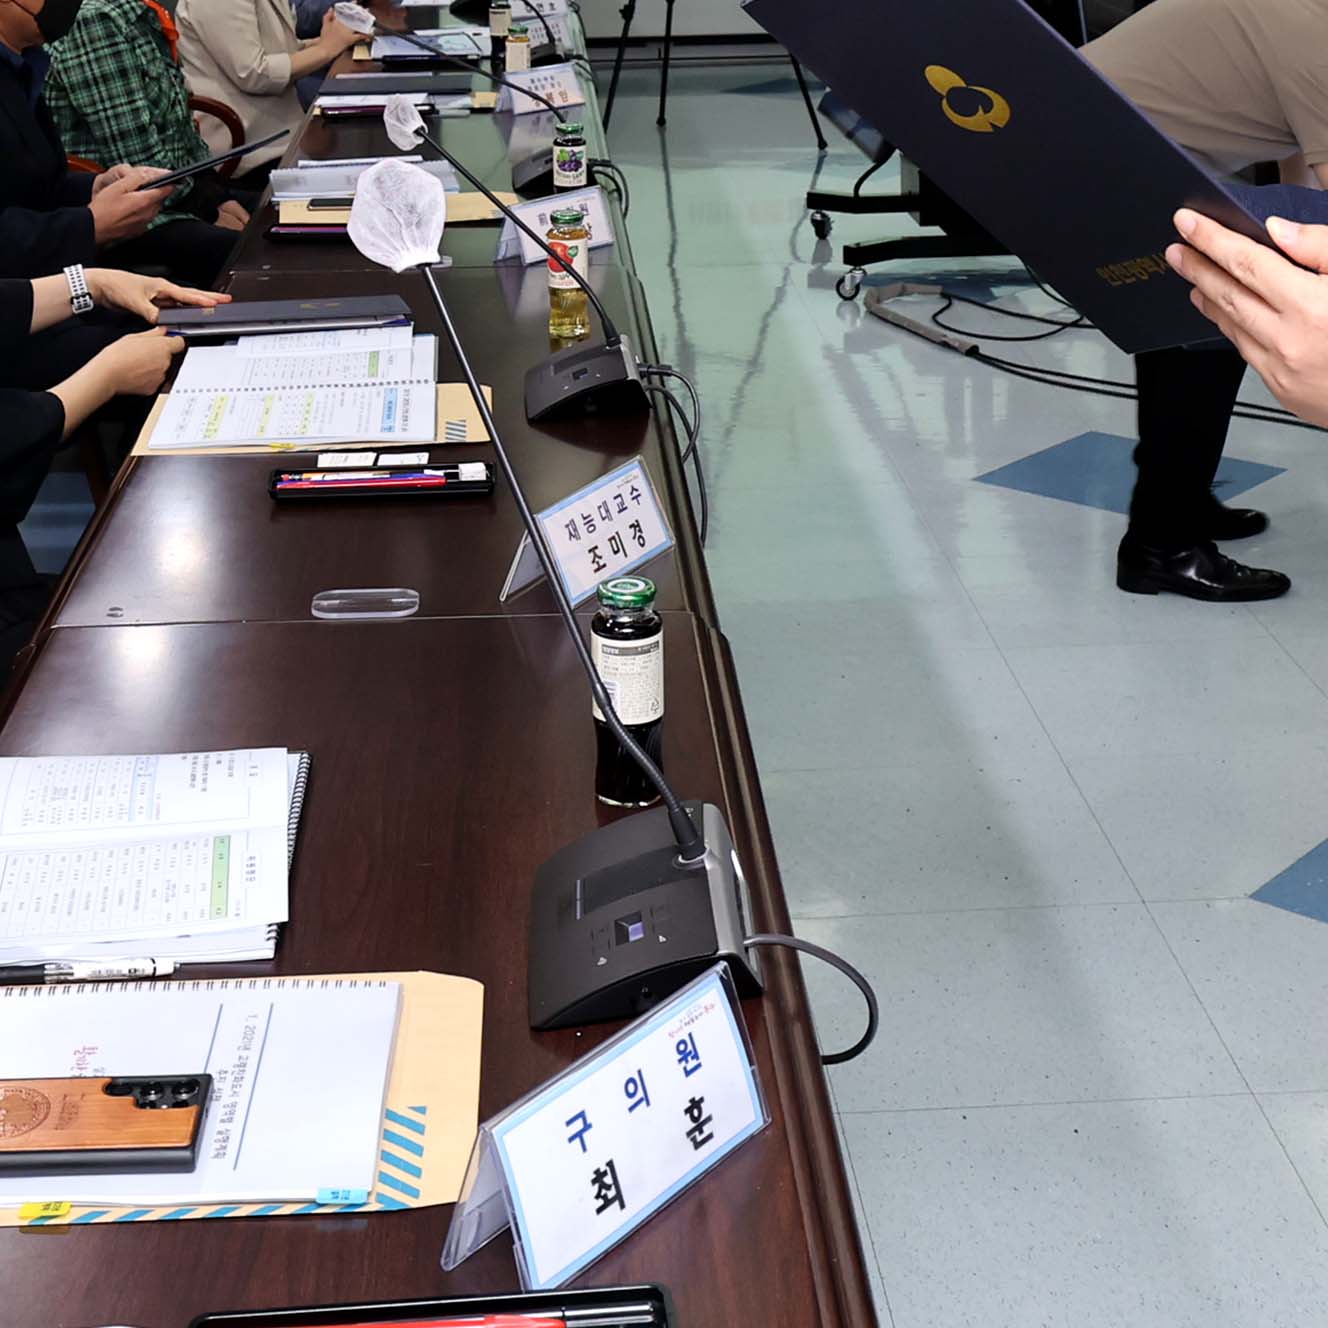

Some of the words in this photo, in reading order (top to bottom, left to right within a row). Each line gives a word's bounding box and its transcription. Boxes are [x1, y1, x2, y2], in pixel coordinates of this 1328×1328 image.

[564, 484, 643, 541] 재능대교수
[587, 519, 646, 573] 조미경
[229, 1055, 250, 1098] 고령친화도시
[564, 1032, 702, 1154] 구의원
[590, 1095, 714, 1216] 최훈
